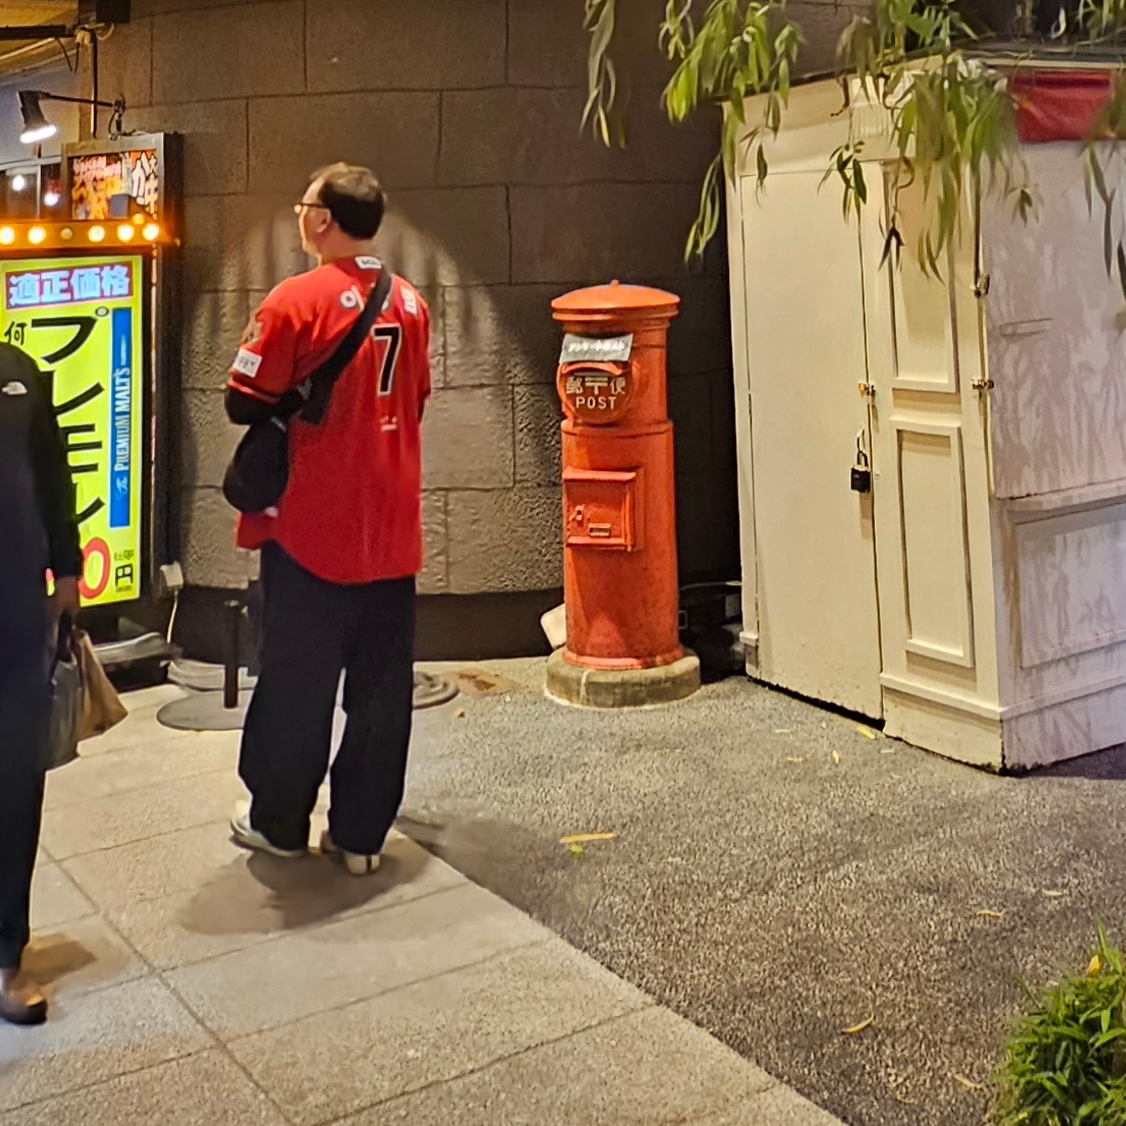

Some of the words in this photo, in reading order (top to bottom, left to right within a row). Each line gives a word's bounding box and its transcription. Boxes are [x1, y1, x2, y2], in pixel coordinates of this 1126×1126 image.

[8, 265, 130, 306] 適正価格
[372, 324, 402, 397] 7
[576, 396, 617, 410] POST
